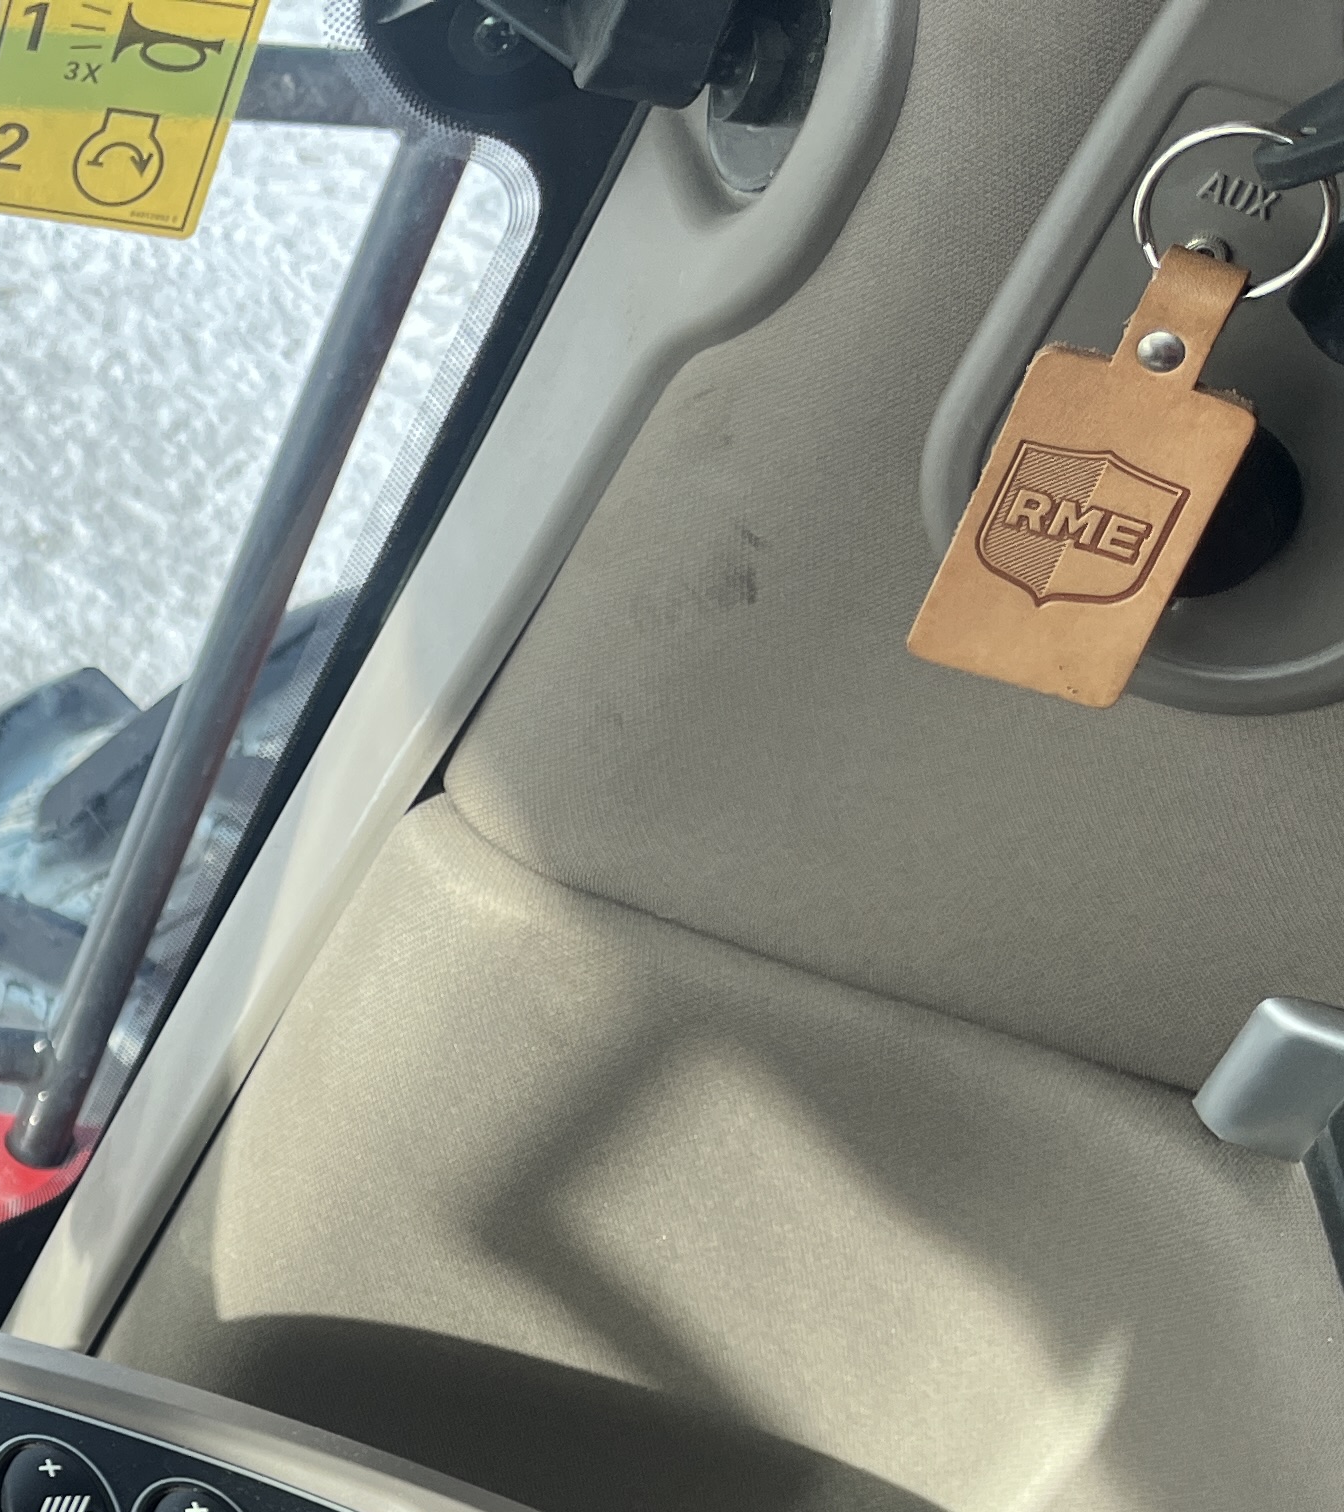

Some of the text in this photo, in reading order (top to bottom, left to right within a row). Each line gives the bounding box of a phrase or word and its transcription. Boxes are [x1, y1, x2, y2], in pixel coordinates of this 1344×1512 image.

[22, 1, 50, 51] 1
[1197, 170, 1282, 221] AUX
[1006, 490, 1153, 565] RME
